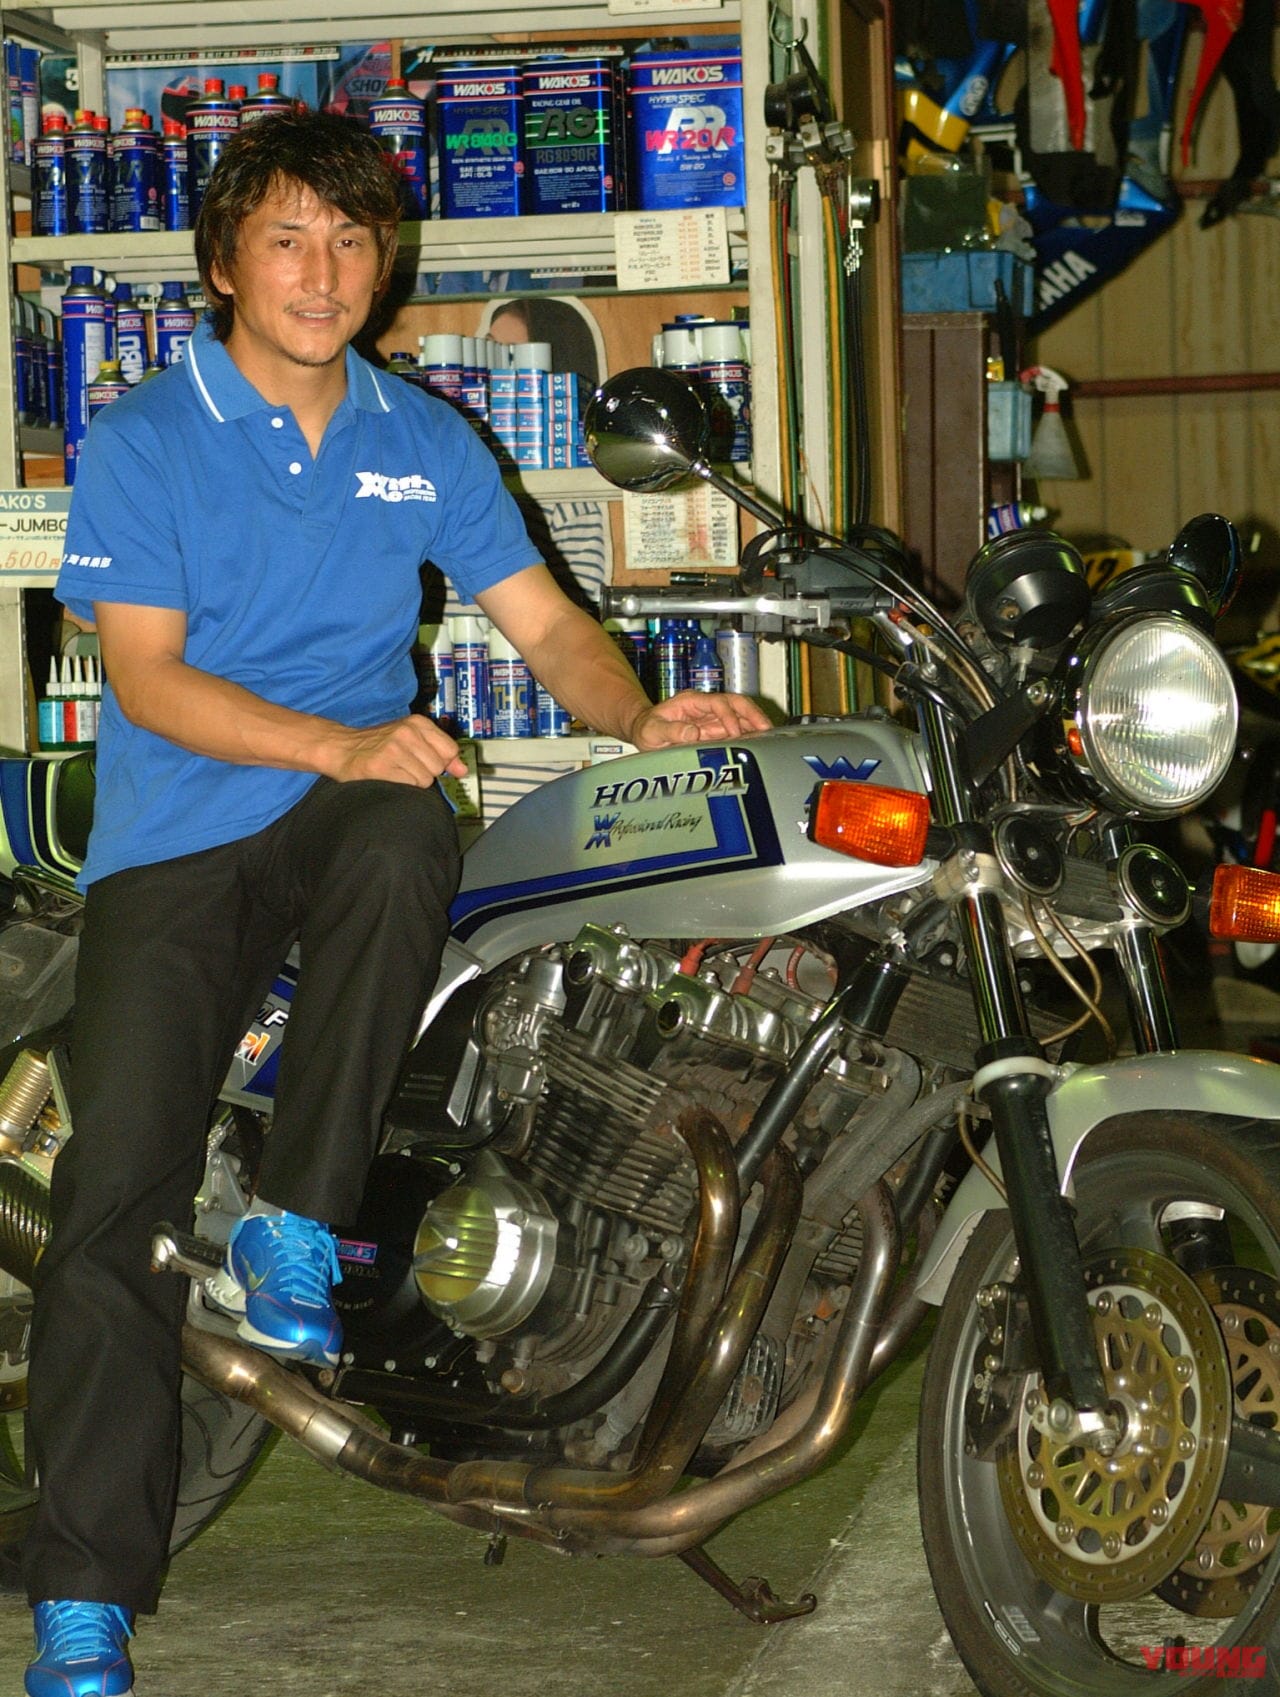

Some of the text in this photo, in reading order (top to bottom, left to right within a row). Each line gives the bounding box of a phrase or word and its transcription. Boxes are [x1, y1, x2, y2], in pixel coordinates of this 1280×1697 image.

[493, 686, 528, 710] THC
[591, 767, 748, 809] HONDA
[666, 811, 703, 832] Racing
